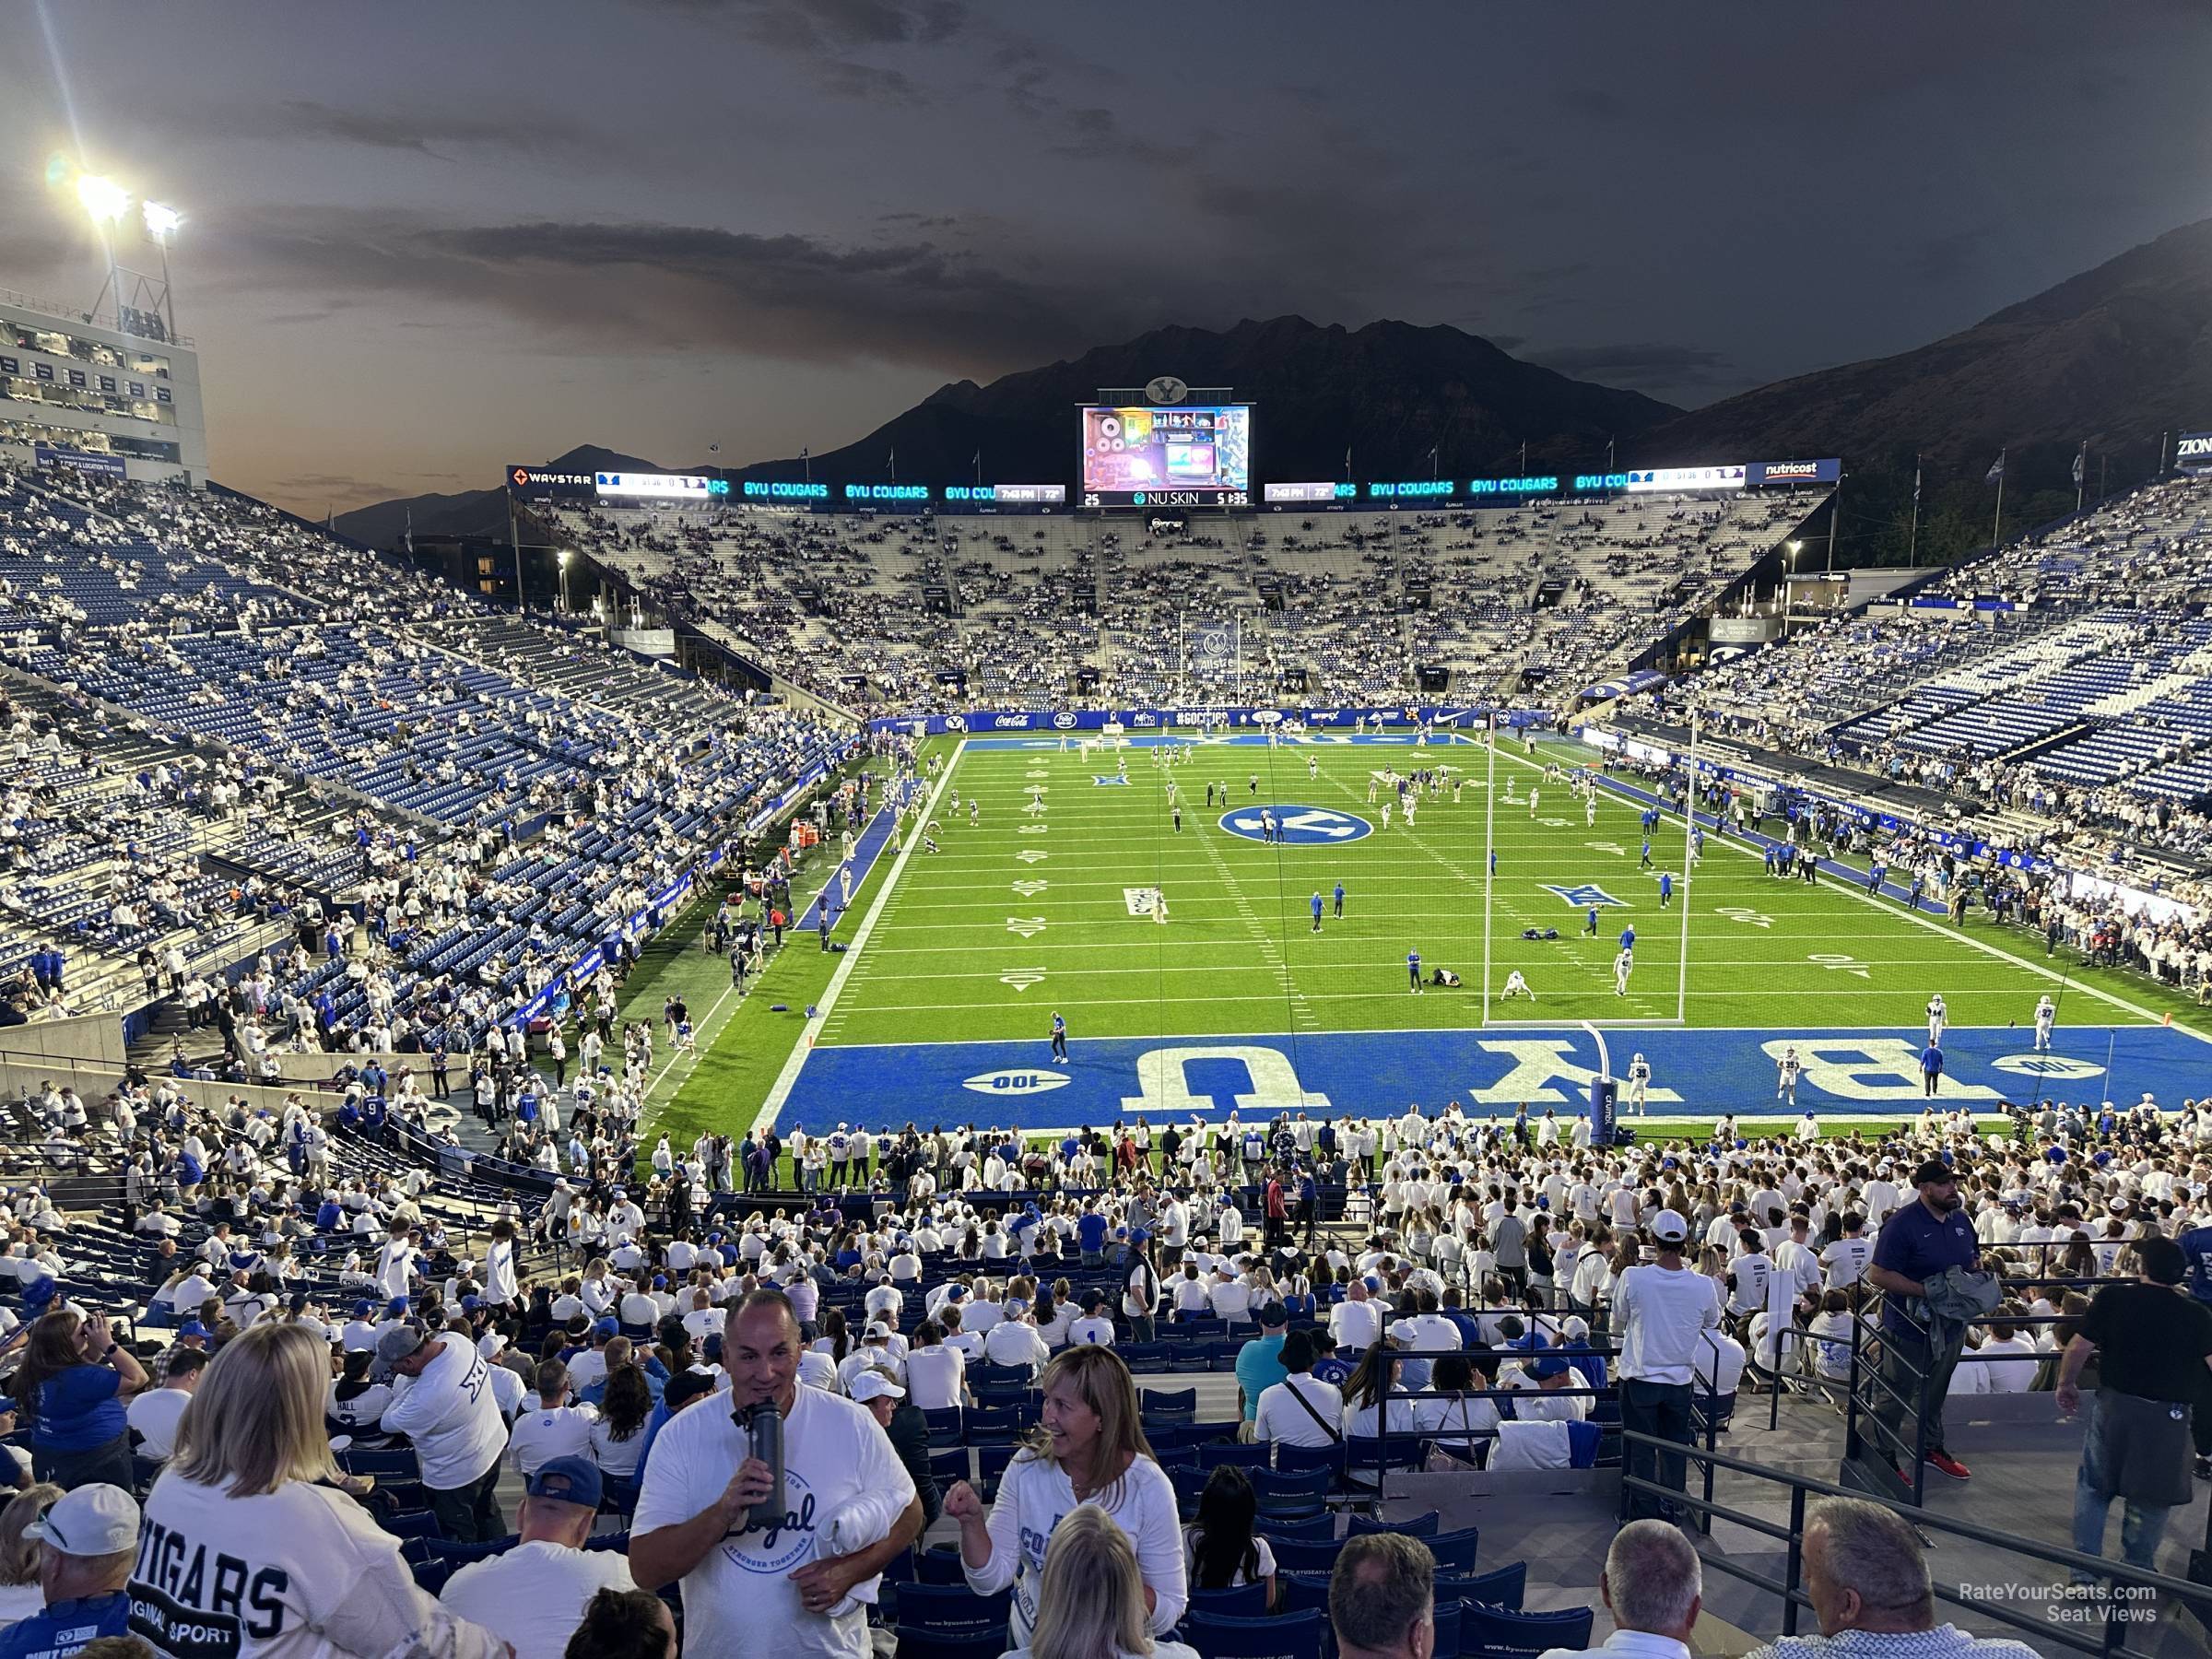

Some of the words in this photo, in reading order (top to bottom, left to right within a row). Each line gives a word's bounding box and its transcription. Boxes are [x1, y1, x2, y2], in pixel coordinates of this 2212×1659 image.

[1765, 462, 1818, 475] nutricost
[529, 473, 592, 485] WAYSTAR
[1472, 480, 1497, 492] BYU
[1500, 477, 1558, 491] COUGARS
[1576, 476, 1601, 488] BYU
[744, 482, 769, 495] BYU
[771, 482, 828, 497] COUGARS
[845, 485, 870, 498] BYU
[873, 486, 928, 499] COUGARS
[946, 487, 969, 500] BYU
[1371, 483, 1394, 496] BYU
[1398, 481, 1453, 495] COUGARS
[1084, 493, 1100, 506] 25
[1148, 492, 1168, 505] NU
[1171, 492, 1199, 505] SKIN
[1011, 879, 1048, 892] 30
[1006, 916, 1047, 932] 20
[999, 967, 1047, 983] 10
[577, 1090, 590, 1101] 96
[369, 1102, 377, 1115] 9
[832, 1135, 845, 1149] 96
[336, 1401, 357, 1412] HALL
[770, 1537, 808, 1568] TOGETHER
[169, 1621, 231, 1643] SPORT
